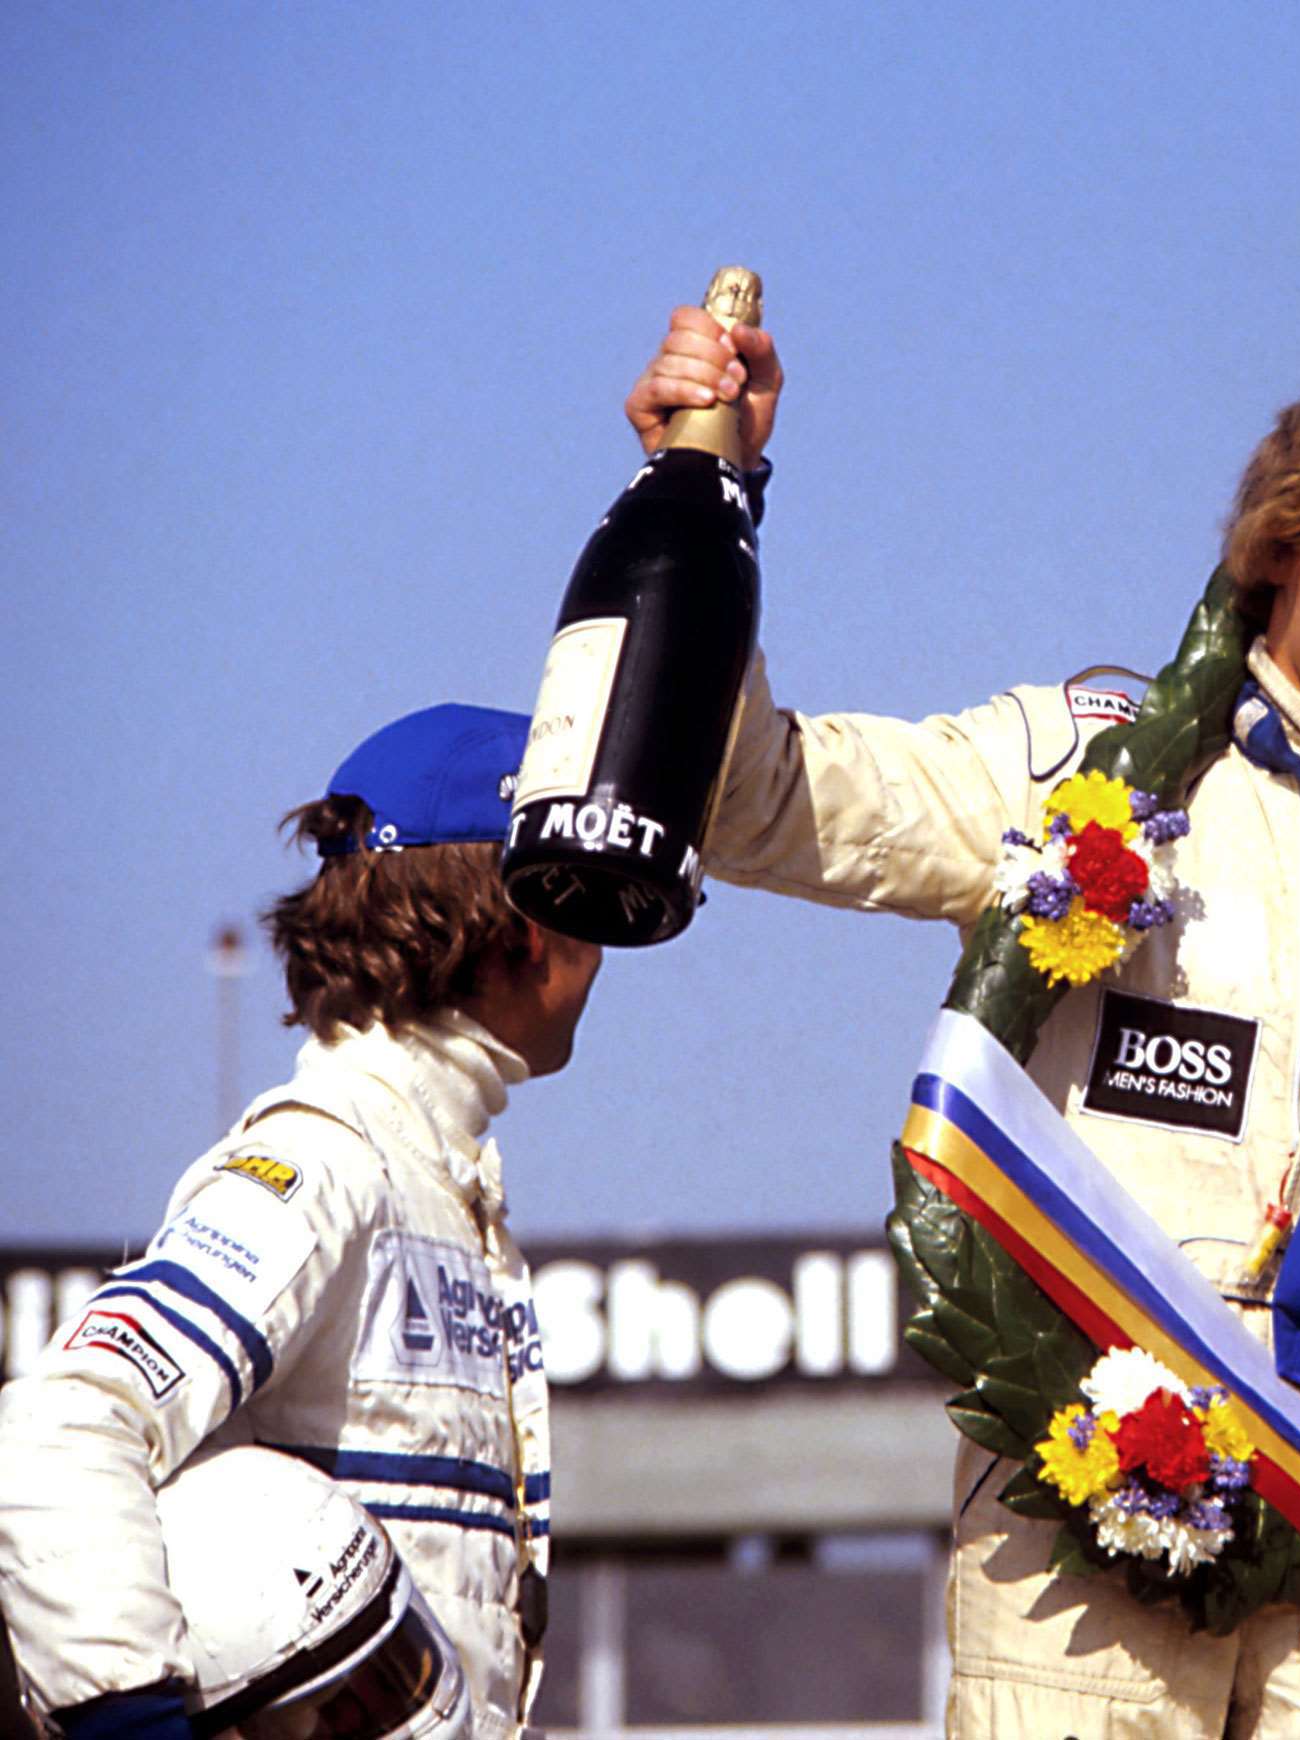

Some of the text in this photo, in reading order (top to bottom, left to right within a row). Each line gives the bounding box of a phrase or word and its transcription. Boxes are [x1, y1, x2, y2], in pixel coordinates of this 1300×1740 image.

[1074, 695, 1136, 719] CHAM
[539, 802, 665, 858] MOËT
[1114, 1027, 1233, 1085] BOSS
[1104, 1070, 1234, 1108] MEN'S FASHION
[81, 1325, 170, 1383] CHAMPION
